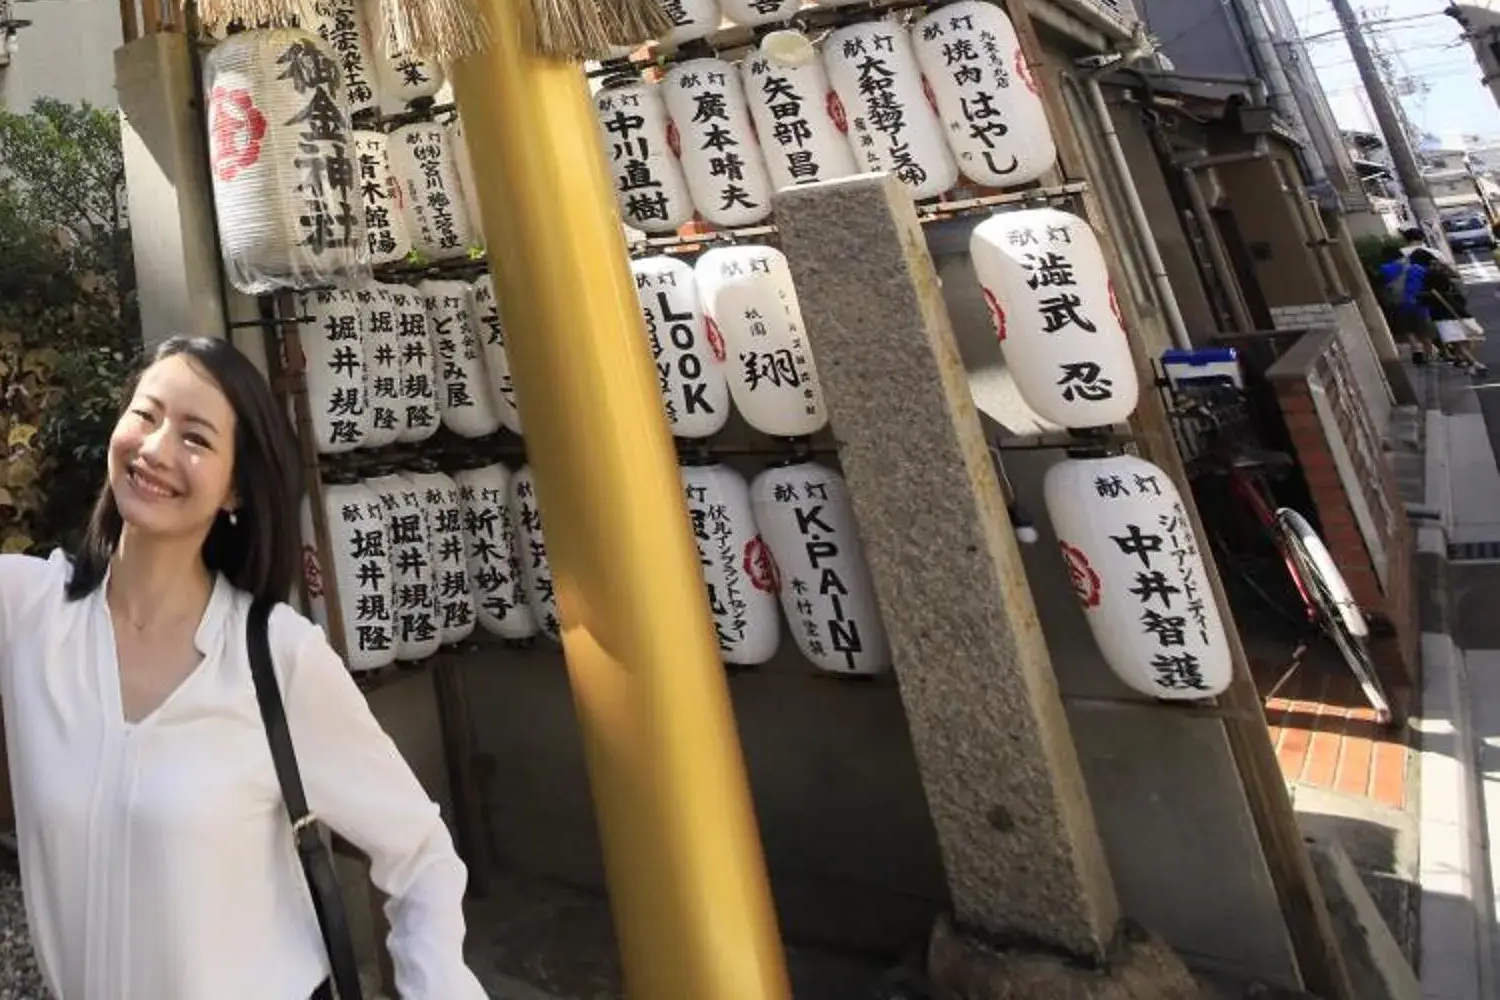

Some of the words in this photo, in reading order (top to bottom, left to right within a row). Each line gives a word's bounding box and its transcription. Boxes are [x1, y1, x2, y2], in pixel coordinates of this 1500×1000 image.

[679, 72, 725, 88] 献灯
[843, 34, 894, 58] 献灯
[922, 15, 974, 41] 献灯
[942, 39, 981, 86] 焼肉
[276, 39, 360, 254] 御金神社
[598, 93, 640, 111] 献灯
[691, 91, 759, 211] 廣本晴夫
[762, 75, 820, 185] 矢田部昌
[960, 92, 1018, 175] はやし
[605, 111, 669, 222] 中川直樹
[1006, 224, 1071, 246] 献灯
[323, 315, 364, 443] 堀井規隆
[369, 311, 401, 430] 堀井規隆
[399, 313, 434, 428] 堀井規隆
[433, 317, 475, 409] ときみ屋
[657, 292, 714, 414] LOOK
[739, 350, 801, 392] 翔
[342, 503, 383, 523] 献灯
[773, 482, 828, 502] 献灯
[1094, 474, 1162, 499] 献灯
[350, 529, 392, 651] 堀井規隆
[391, 512, 437, 642] 堀井規隆
[435, 509, 473, 630] 堀井規隆
[463, 507, 513, 620] 新木妙子
[794, 505, 862, 670] K.PAINT
[1109, 524, 1213, 691] 中井智護
